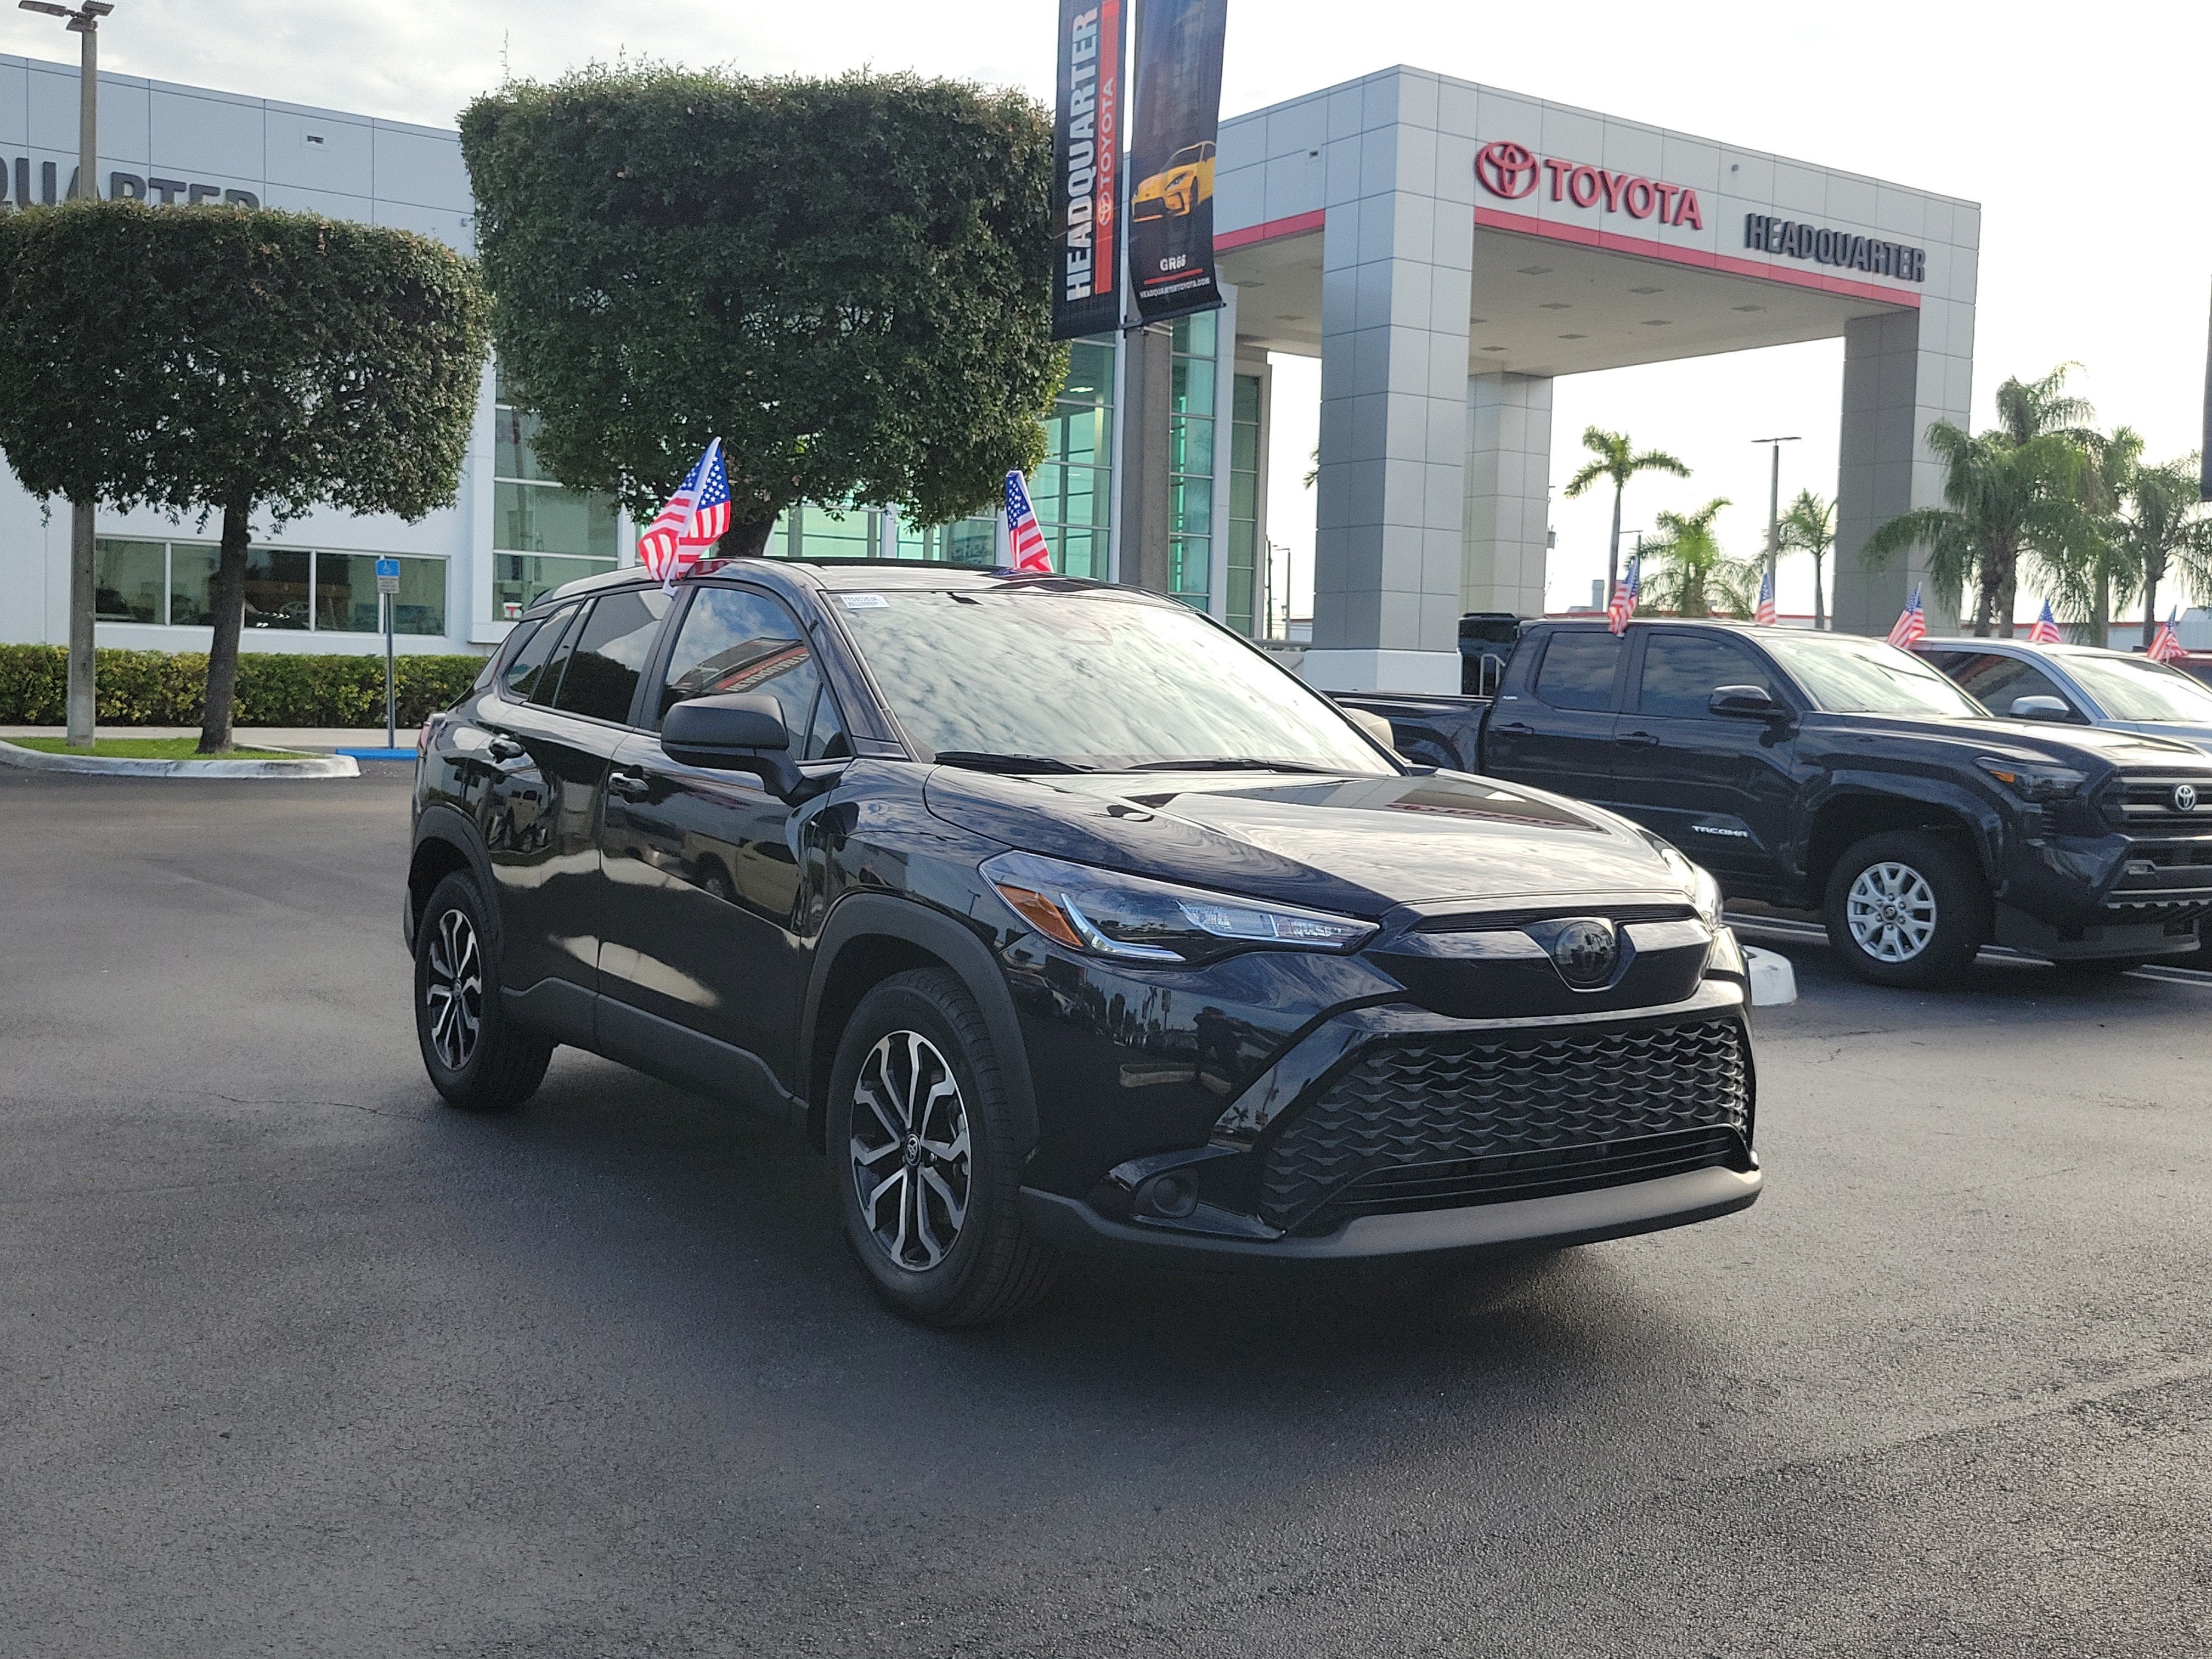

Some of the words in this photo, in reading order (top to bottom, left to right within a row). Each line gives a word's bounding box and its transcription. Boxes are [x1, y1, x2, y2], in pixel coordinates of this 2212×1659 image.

[1066, 7, 1098, 301] HEADQUARTER
[1099, 77, 1114, 190] TOYOTA
[1544, 159, 1703, 230] TOYOTA
[1160, 254, 1187, 272] GR86
[1743, 213, 1926, 283] HEADQUARTER
[1691, 825, 1749, 838] TACOMA
